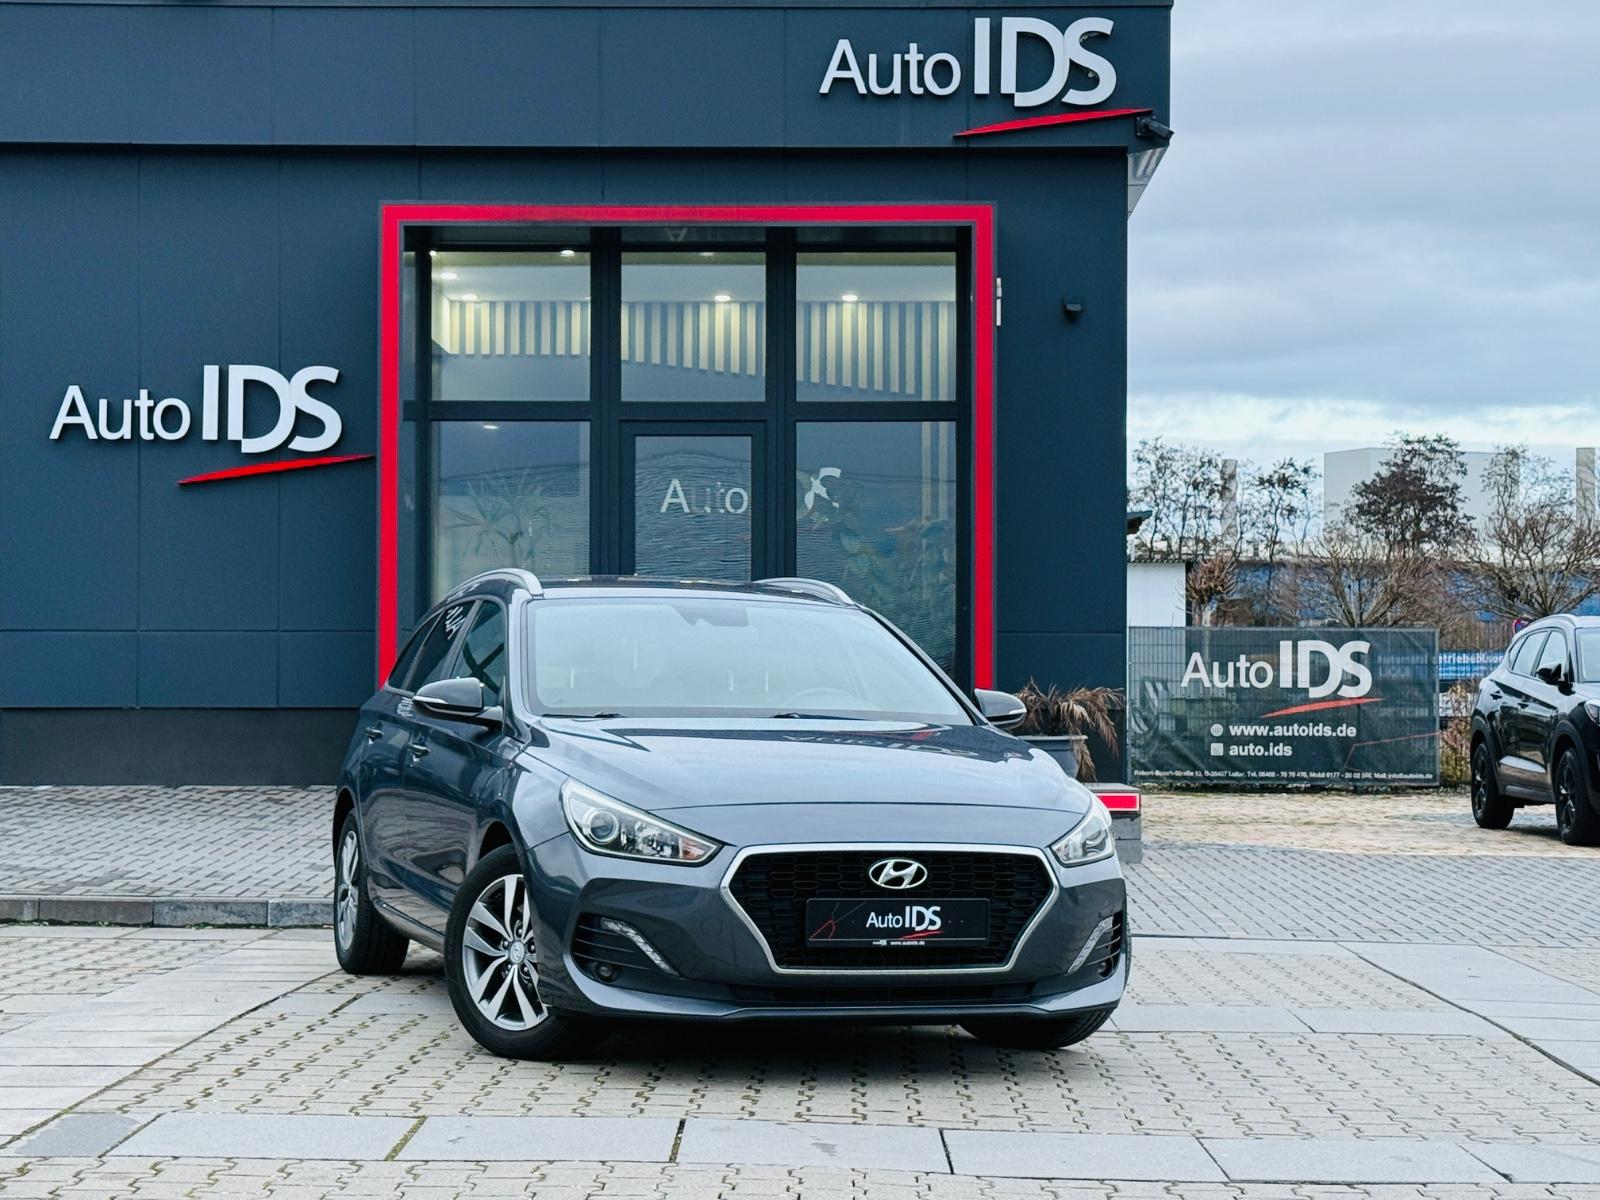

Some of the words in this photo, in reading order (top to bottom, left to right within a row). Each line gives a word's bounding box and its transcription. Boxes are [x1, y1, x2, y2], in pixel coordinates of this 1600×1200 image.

[819, 39, 962, 95] Auto
[974, 16, 1117, 107] IDS
[49, 385, 191, 441] Auto
[202, 364, 343, 453] IDS
[1180, 651, 1274, 689] Auto
[1279, 640, 1373, 699] IDS
[1229, 723, 1357, 737] www.autoids.de
[1229, 743, 1293, 757] auto.ids
[866, 911, 903, 929] Auto
[905, 905, 942, 931] IDS
